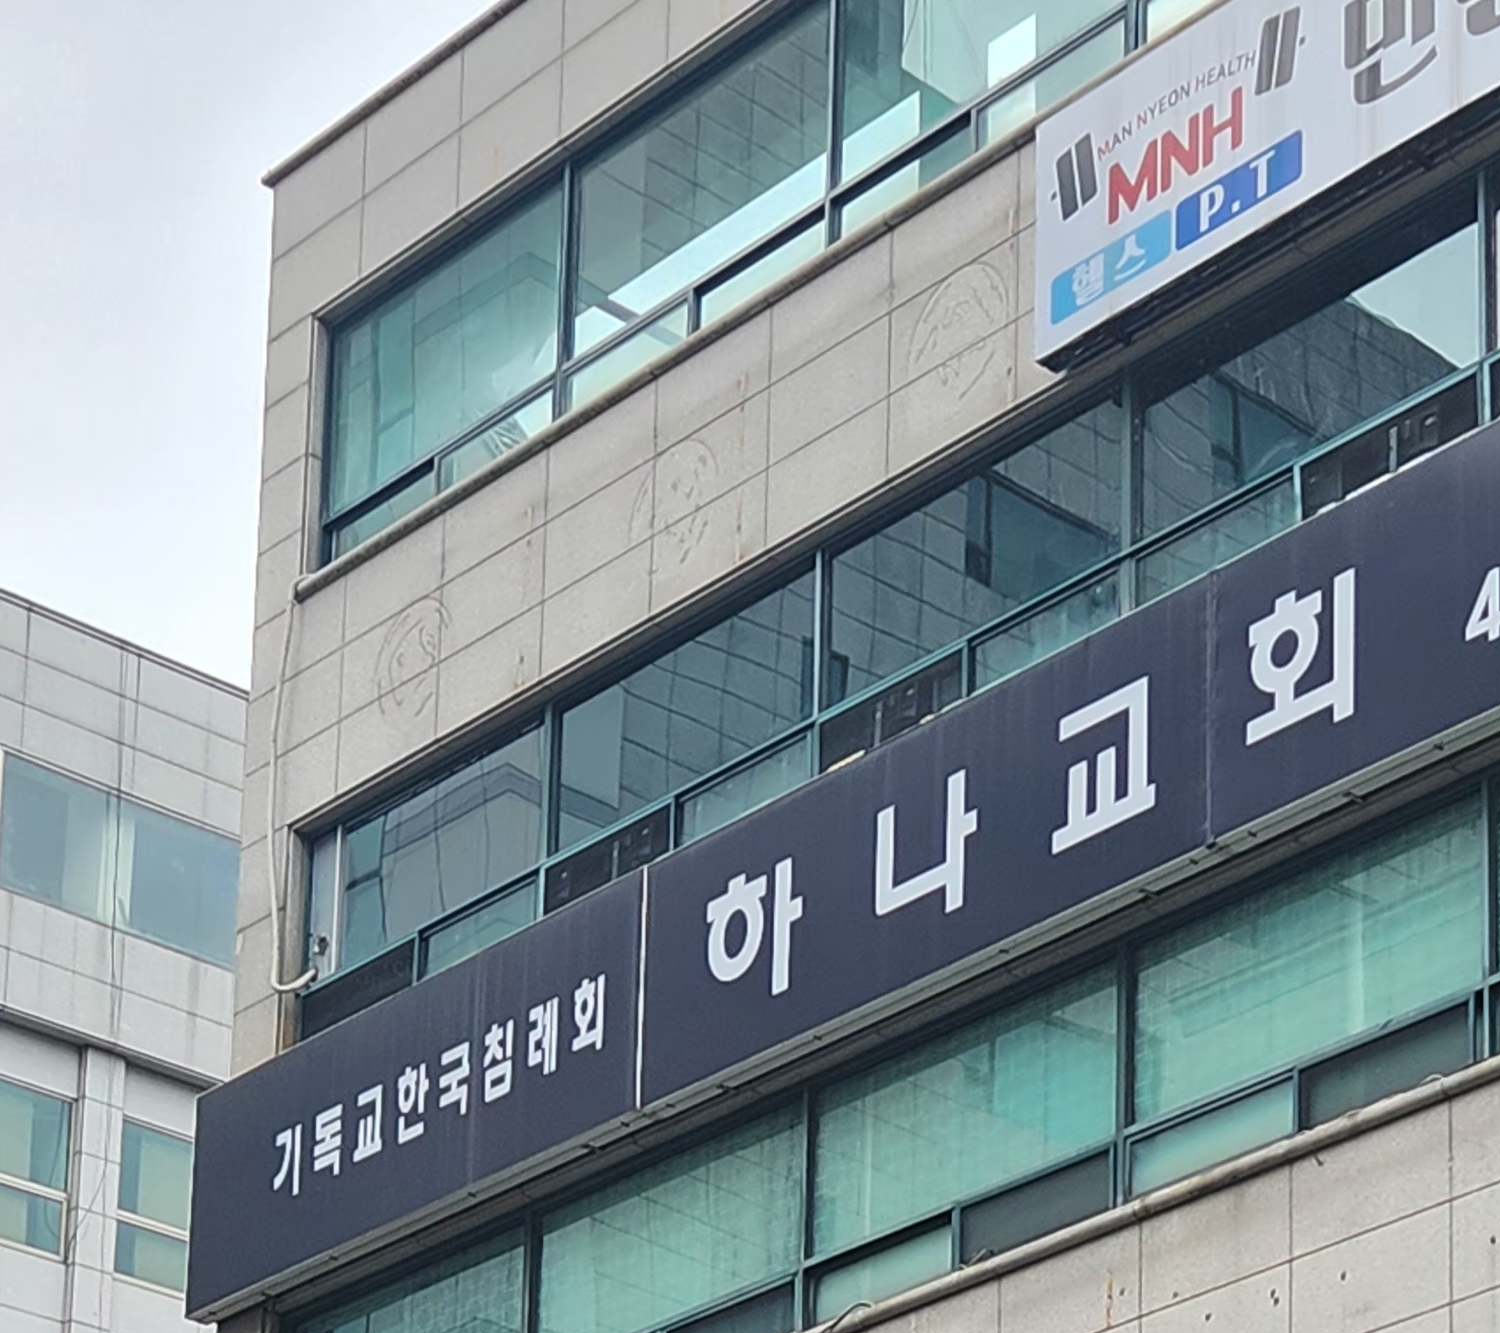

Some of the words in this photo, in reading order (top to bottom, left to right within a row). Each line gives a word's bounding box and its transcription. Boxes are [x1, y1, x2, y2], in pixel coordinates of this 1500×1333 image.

[1098, 122, 1132, 161] MAN
[1137, 82, 1191, 131] NYEON
[1194, 50, 1256, 93] HEALTH
[1108, 86, 1243, 225] MNH
[1200, 150, 1276, 232] P.T
[1072, 234, 1146, 307] 헬스
[271, 972, 607, 1198] 기독교한국침례회
[704, 567, 1358, 997] 하나교회
